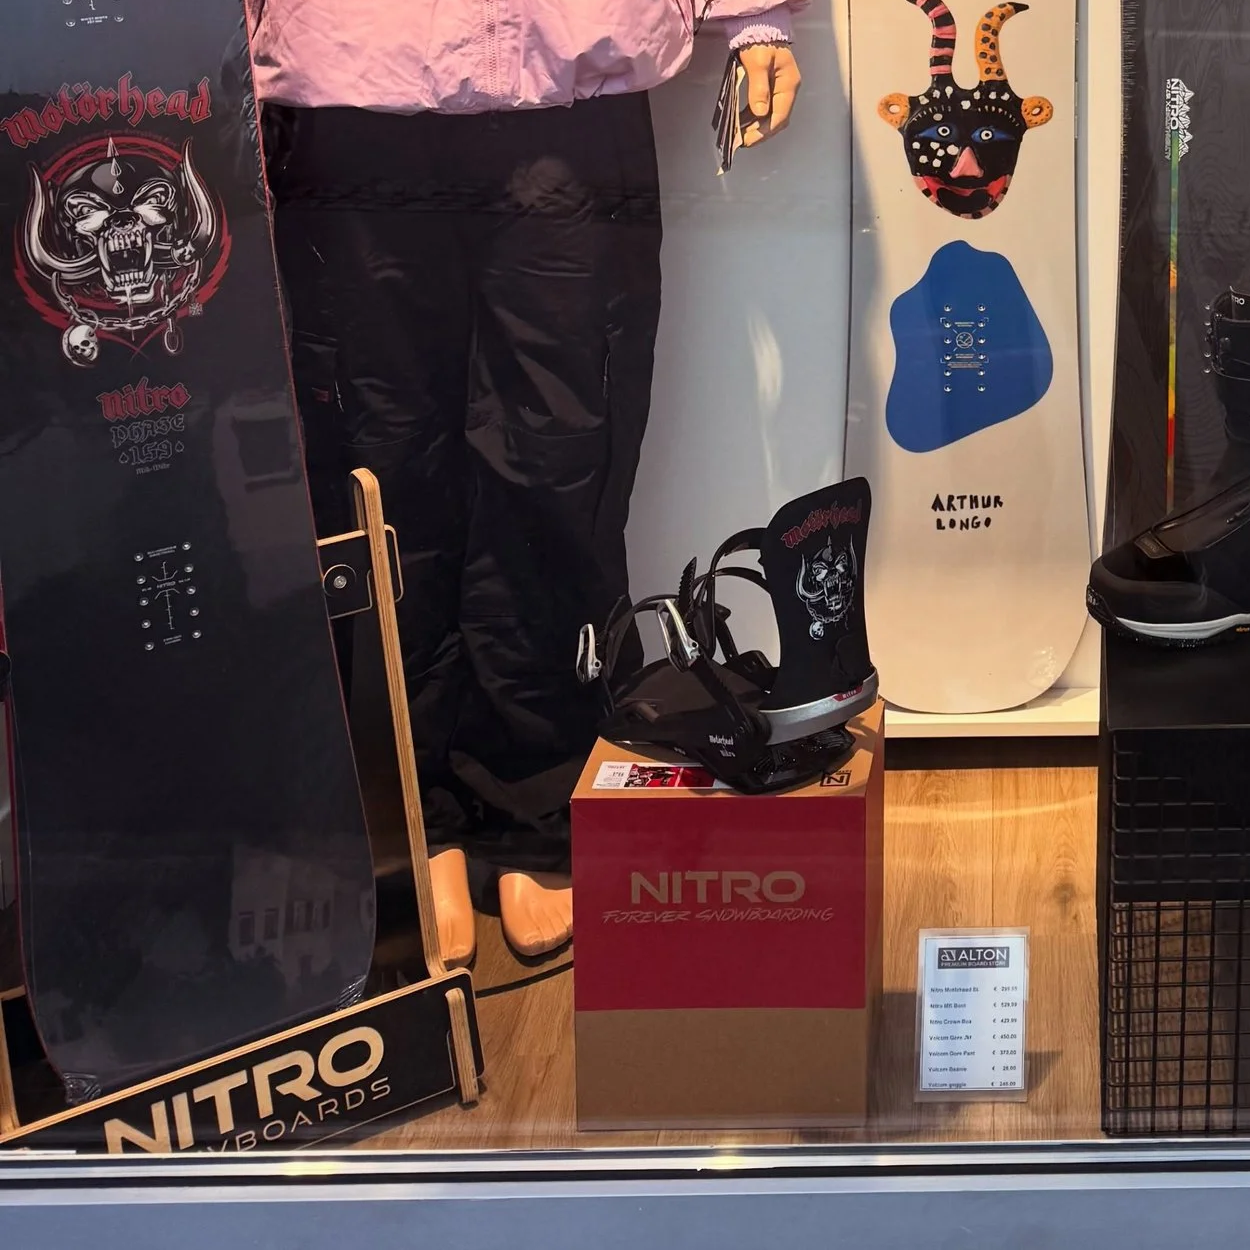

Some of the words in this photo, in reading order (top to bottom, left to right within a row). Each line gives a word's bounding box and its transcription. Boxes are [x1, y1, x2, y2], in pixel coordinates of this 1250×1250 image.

[1171, 78, 1180, 130] NITRO
[931, 493, 1003, 512] ARTHUR
[936, 516, 991, 531] LONGO
[631, 870, 806, 904] NITRO
[602, 909, 692, 924] FOREVER
[695, 907, 834, 923] SNOWBOARDING
[958, 948, 1007, 961] ALTON
[103, 1025, 385, 1154] NITRO
